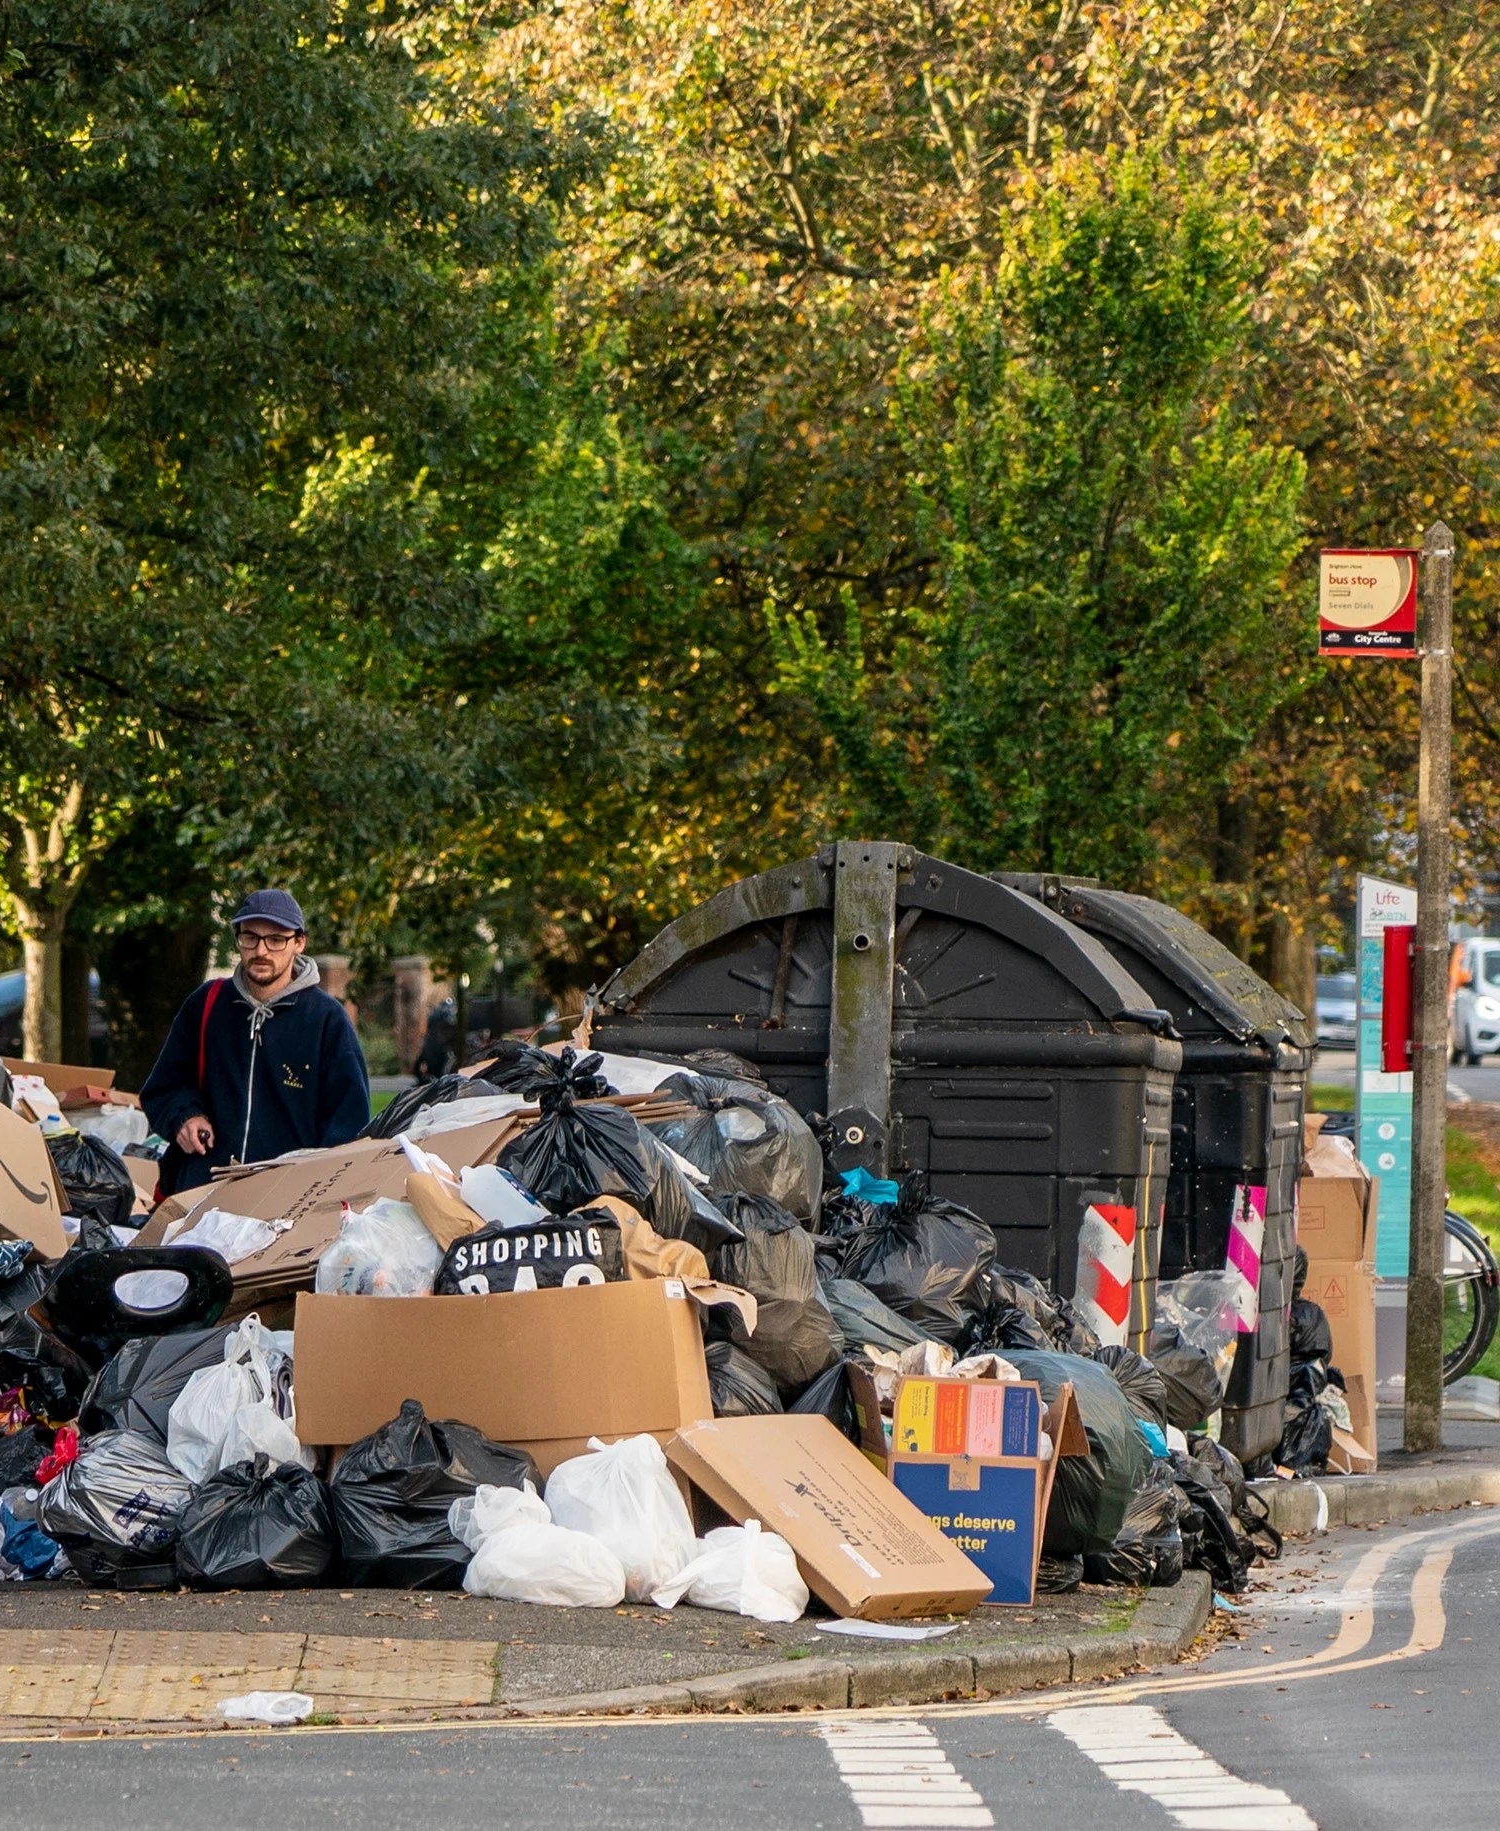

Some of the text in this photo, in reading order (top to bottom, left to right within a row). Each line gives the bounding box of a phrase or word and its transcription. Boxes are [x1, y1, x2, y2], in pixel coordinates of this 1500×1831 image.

[1329, 573, 1377, 588] bus stop
[1329, 602, 1374, 610] Seven Dials
[1354, 634, 1402, 645] City Centre
[1375, 888, 1401, 906] Life
[454, 1227, 603, 1272] SHOPPING
[953, 1512, 1016, 1531] deserve
[949, 1535, 988, 1550] etter
